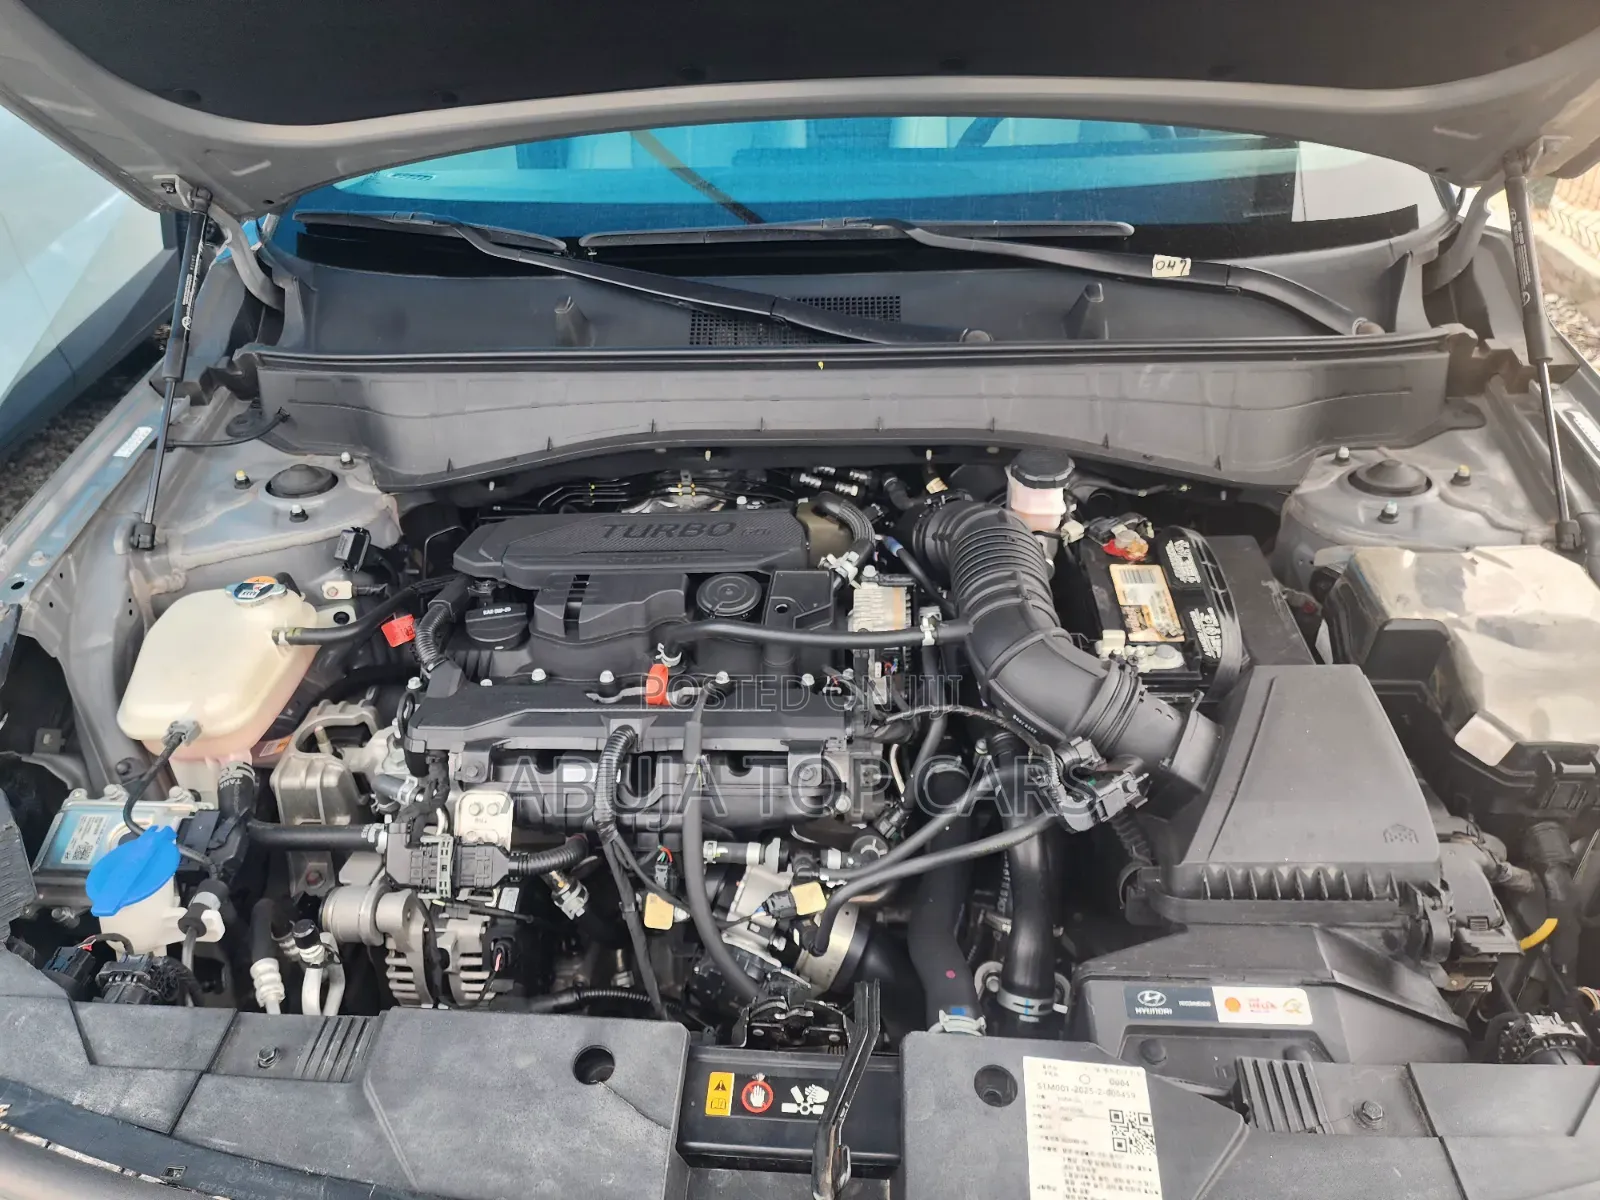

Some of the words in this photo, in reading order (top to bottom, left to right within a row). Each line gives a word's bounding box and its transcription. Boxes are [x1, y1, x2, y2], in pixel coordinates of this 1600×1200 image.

[1155, 259, 1187, 276] 047
[602, 521, 737, 539] TURBO
[1134, 1006, 1173, 1015] HYUNDAI
